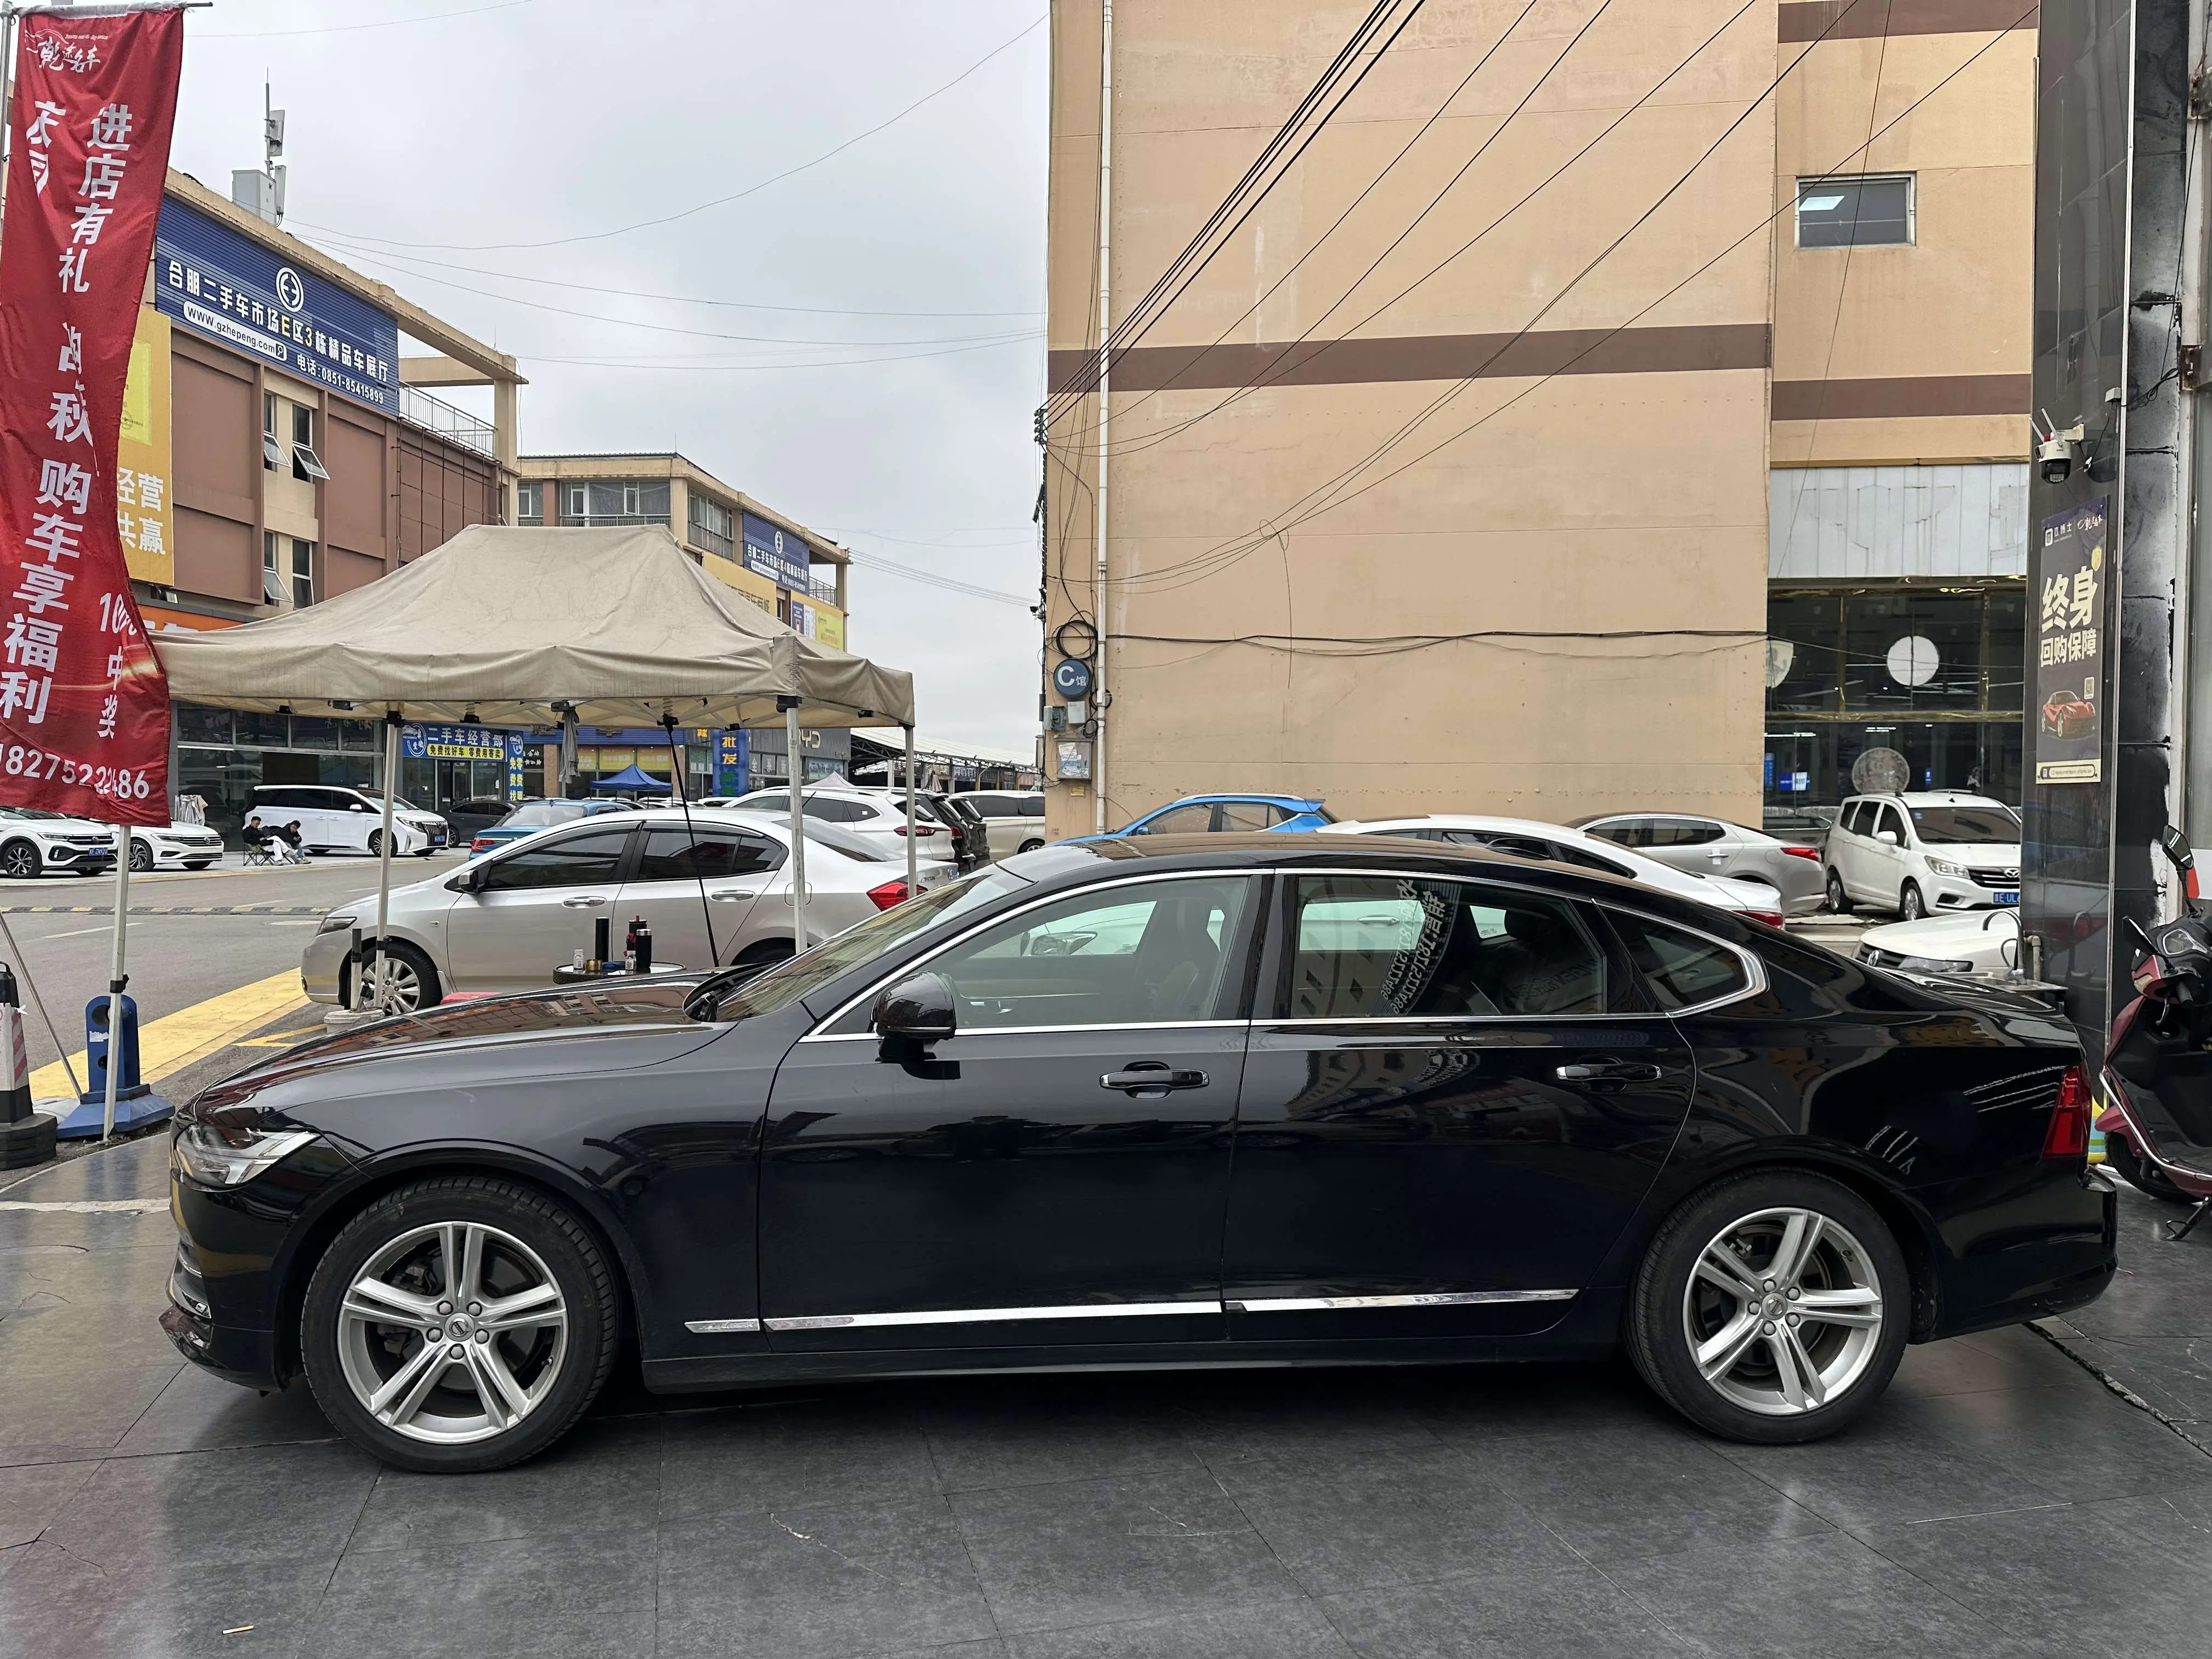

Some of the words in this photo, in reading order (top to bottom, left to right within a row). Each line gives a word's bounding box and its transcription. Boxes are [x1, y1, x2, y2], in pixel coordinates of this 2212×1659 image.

[59, 104, 133, 294] 进店有礼
[168, 259, 388, 383] 合朋二手车市场E区3栋精品车展厅
[188, 305, 275, 354] www.gzhepeng.com
[117, 467, 164, 512] 经营
[0, 459, 92, 724] 购车享福利
[2041, 566, 2098, 633] 终身
[2040, 628, 2097, 668] 回购保障
[427, 727, 504, 748] 二手车经营部
[722, 736, 737, 765] 批发
